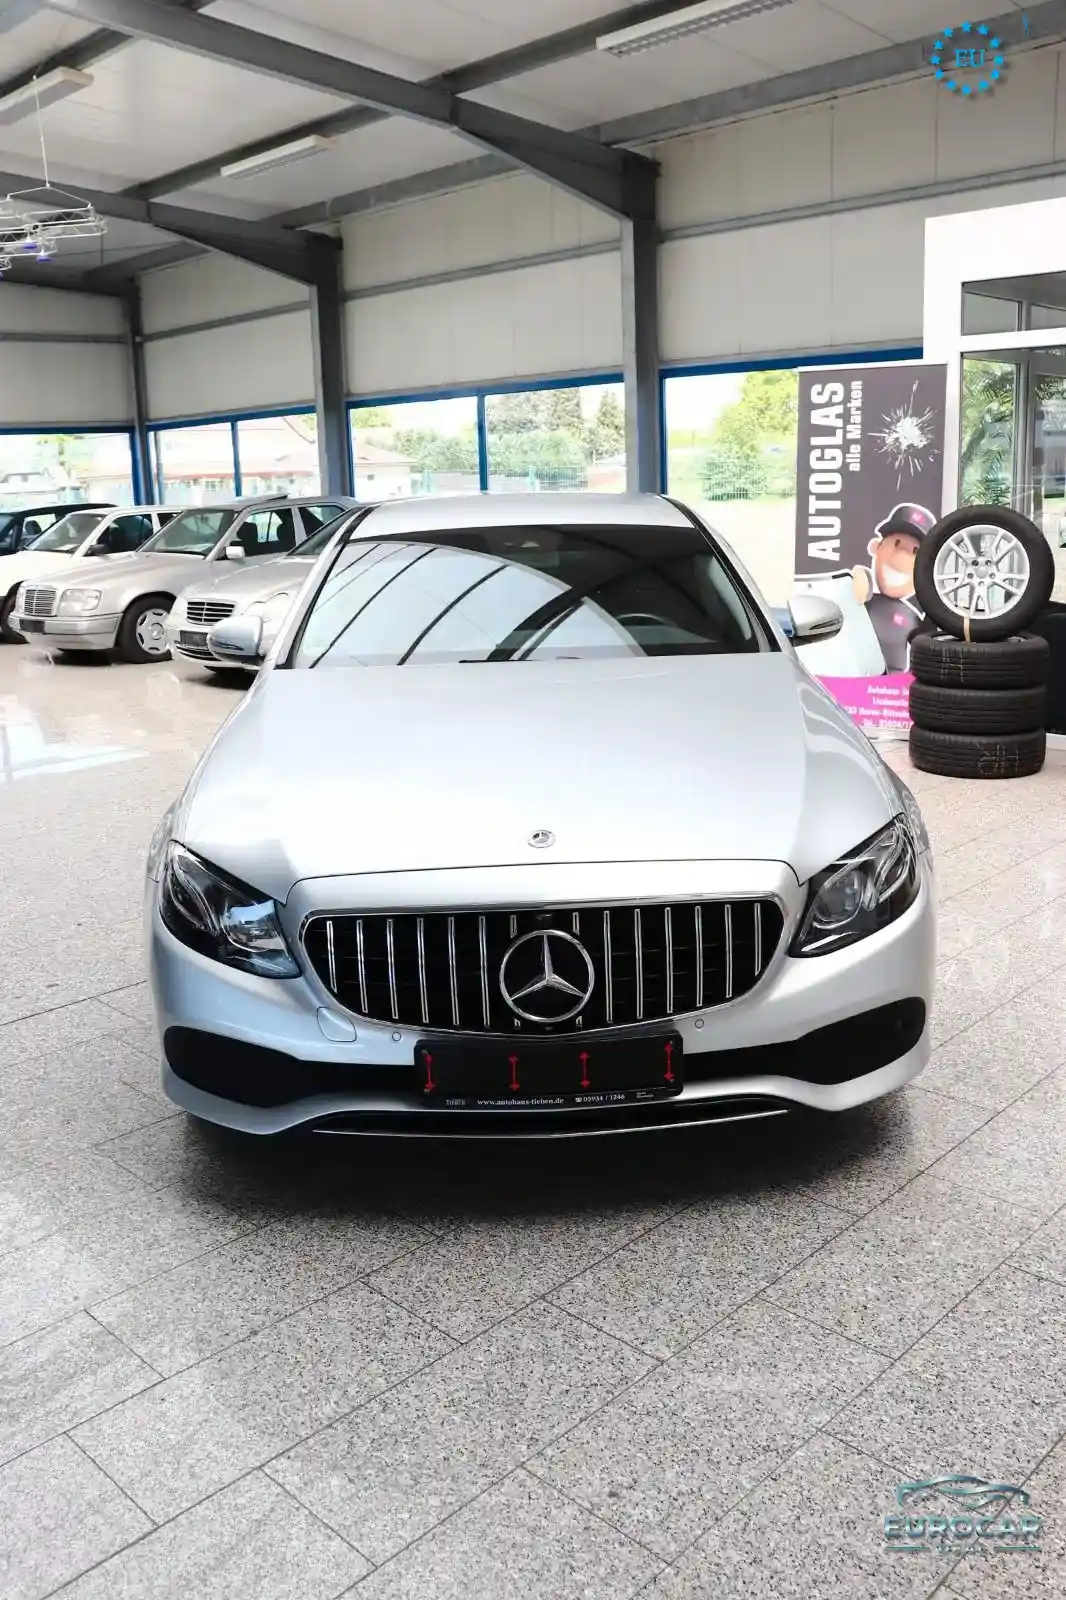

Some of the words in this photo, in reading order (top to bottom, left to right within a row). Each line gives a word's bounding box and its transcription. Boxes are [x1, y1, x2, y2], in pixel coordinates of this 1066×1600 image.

[846, 380, 863, 439] Marken
[807, 382, 844, 562] AUTOGLAS
[845, 444, 861, 472] alle
[477, 1097, 564, 1106] www.autohaus-tieben.de
